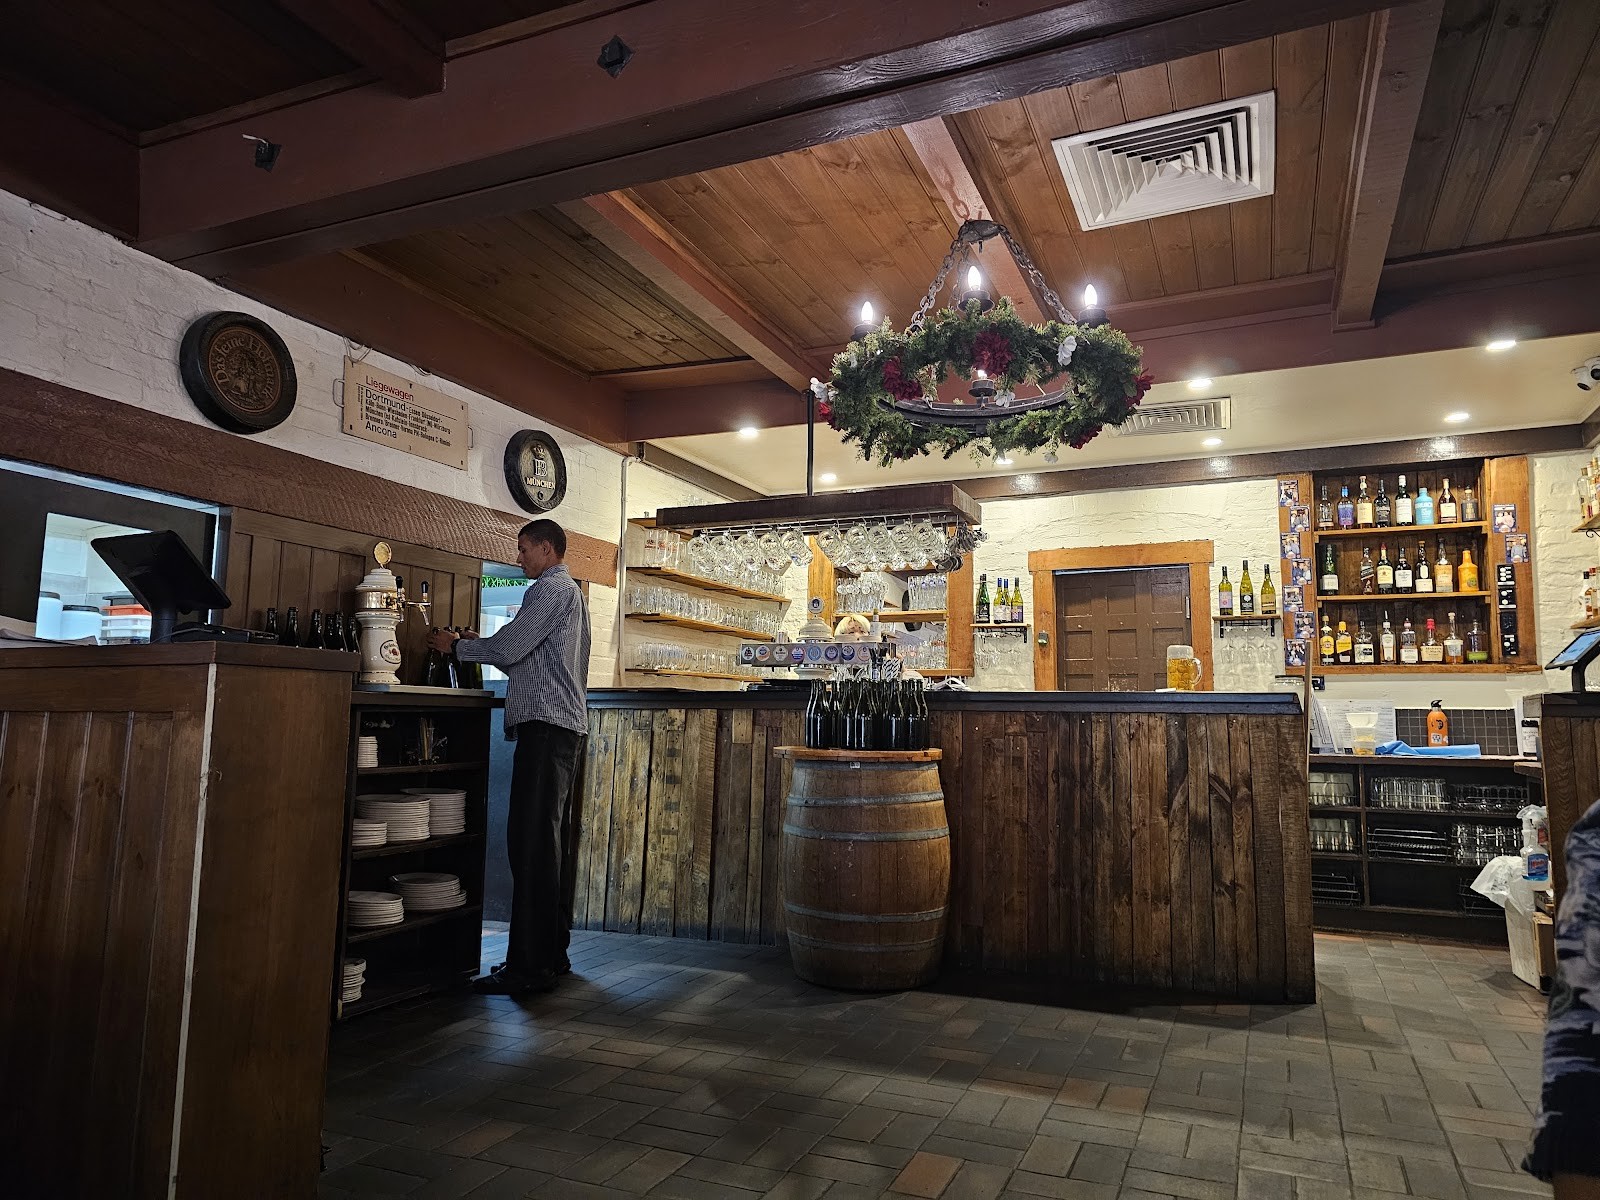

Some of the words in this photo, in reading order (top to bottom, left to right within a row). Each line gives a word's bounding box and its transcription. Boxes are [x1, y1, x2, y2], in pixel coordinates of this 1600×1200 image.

[215, 356, 230, 385] Das
[365, 375, 414, 402] Liegewagen
[365, 420, 397, 439] Ancona
[525, 476, 556, 490] MÜNCHEN
